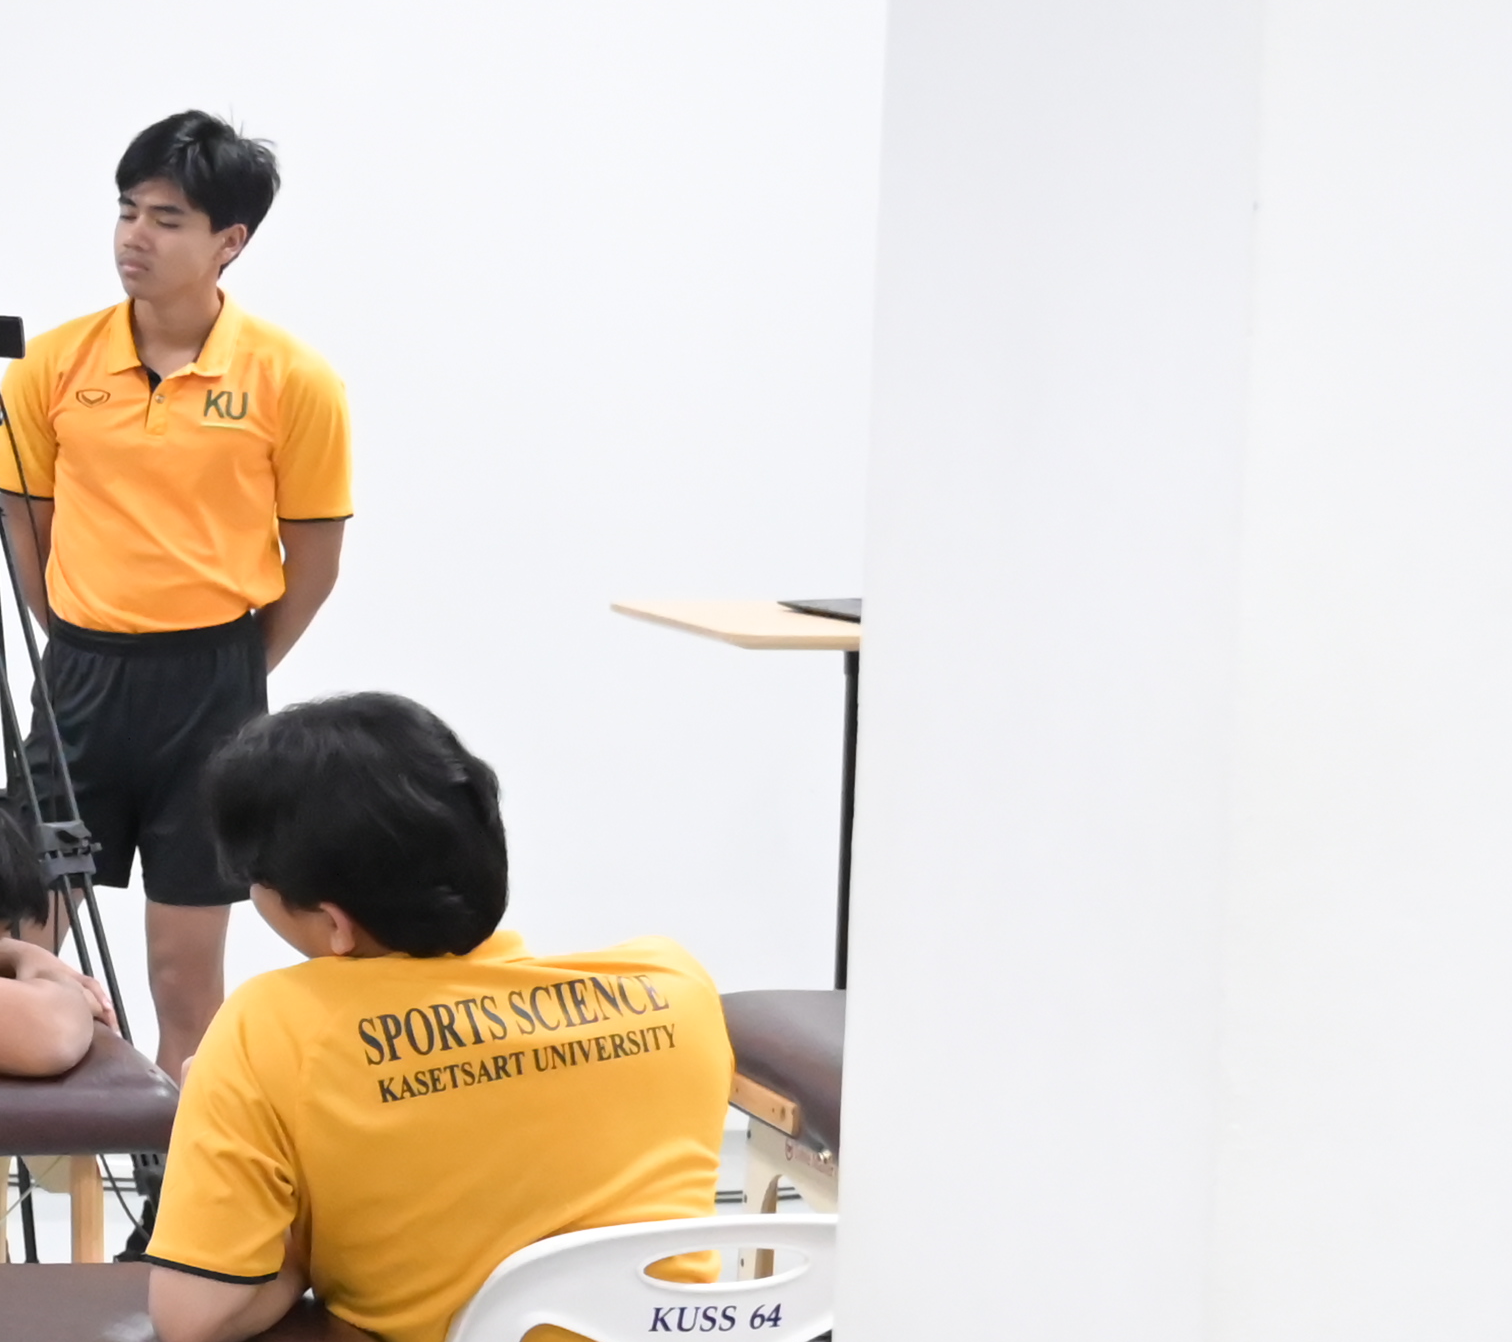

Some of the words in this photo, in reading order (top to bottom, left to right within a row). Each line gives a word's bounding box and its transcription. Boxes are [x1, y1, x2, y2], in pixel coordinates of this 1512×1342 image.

[203, 389, 248, 420] KU
[357, 994, 508, 1067] SPORTS
[507, 974, 670, 1036] SCIENCE
[377, 1050, 526, 1104] KASETSART
[531, 1023, 677, 1073] UNIVERSITY
[648, 1305, 738, 1333] KUSS
[749, 1302, 782, 1330] 64
